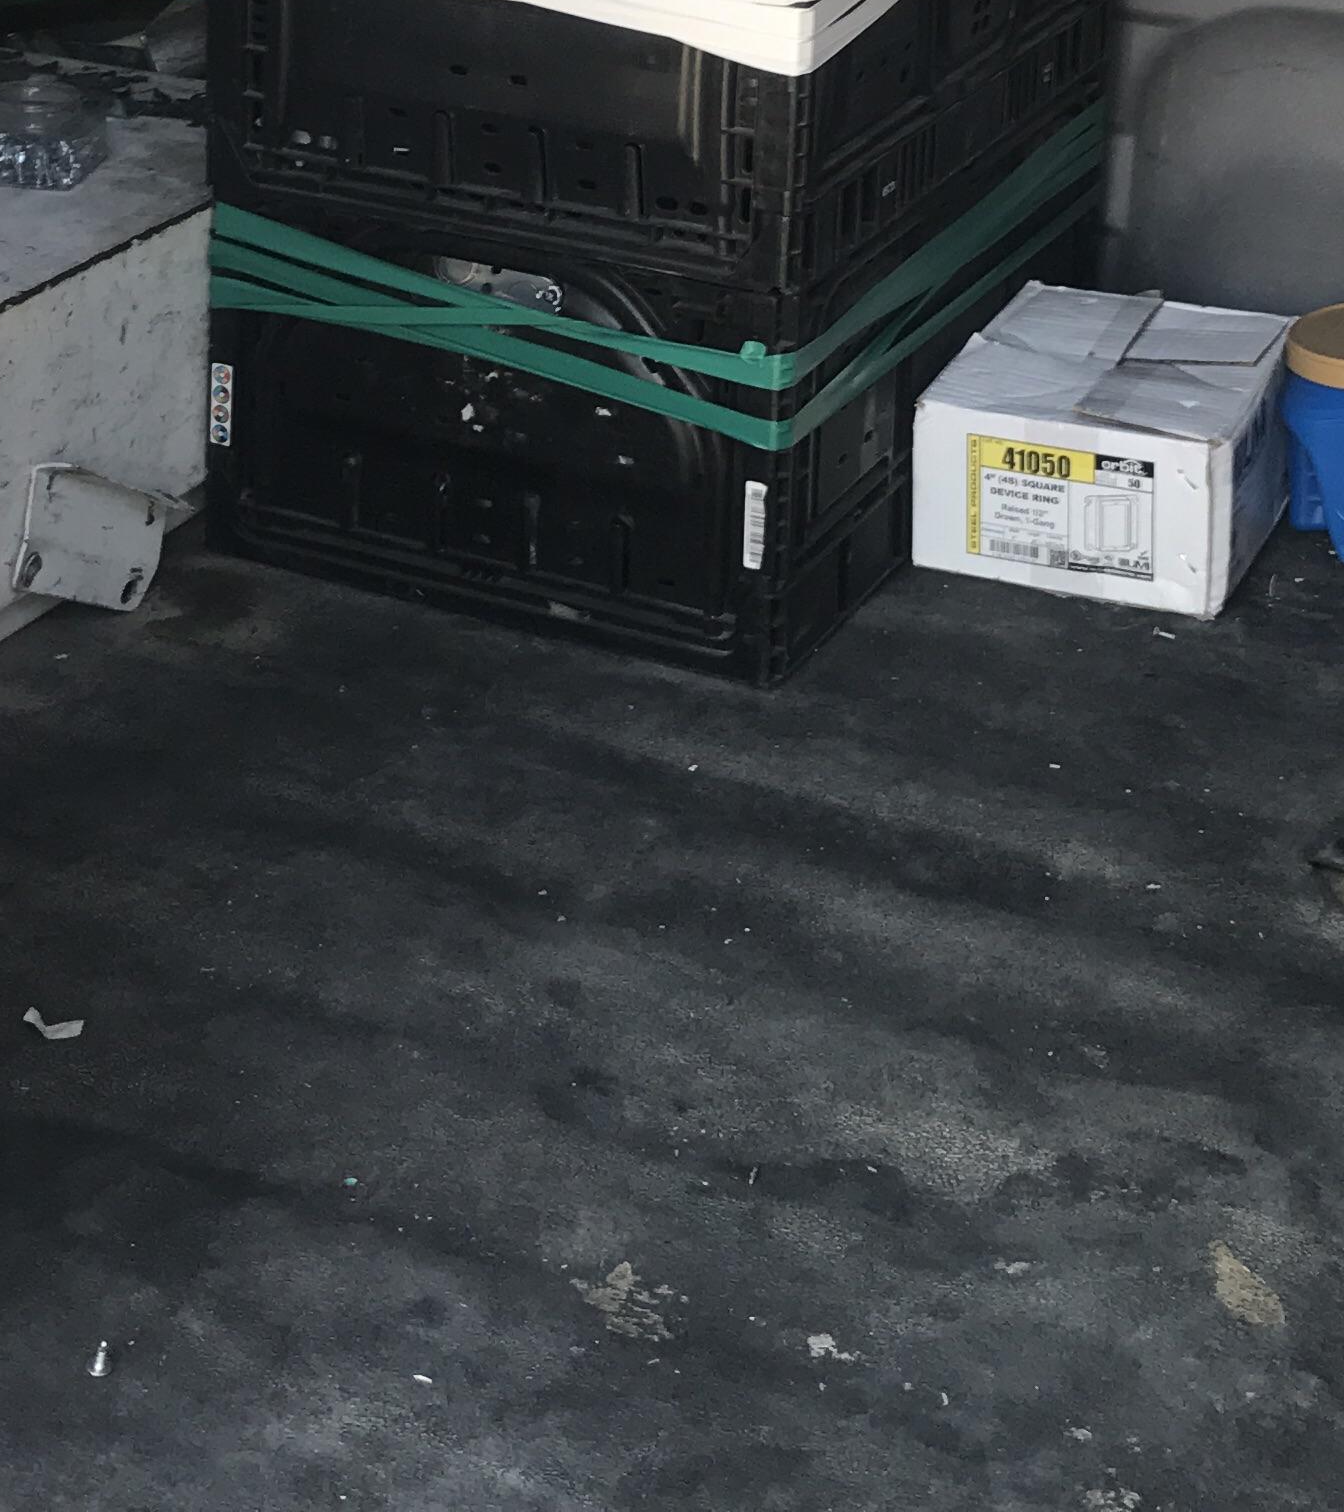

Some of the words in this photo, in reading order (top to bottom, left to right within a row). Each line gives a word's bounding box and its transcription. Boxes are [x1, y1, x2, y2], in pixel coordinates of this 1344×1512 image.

[1001, 446, 1071, 479] 41050
[1100, 458, 1145, 474] orbit
[1021, 478, 1066, 493] SQUARE
[989, 486, 1029, 500] DEVICE
[1032, 493, 1060, 505] RING
